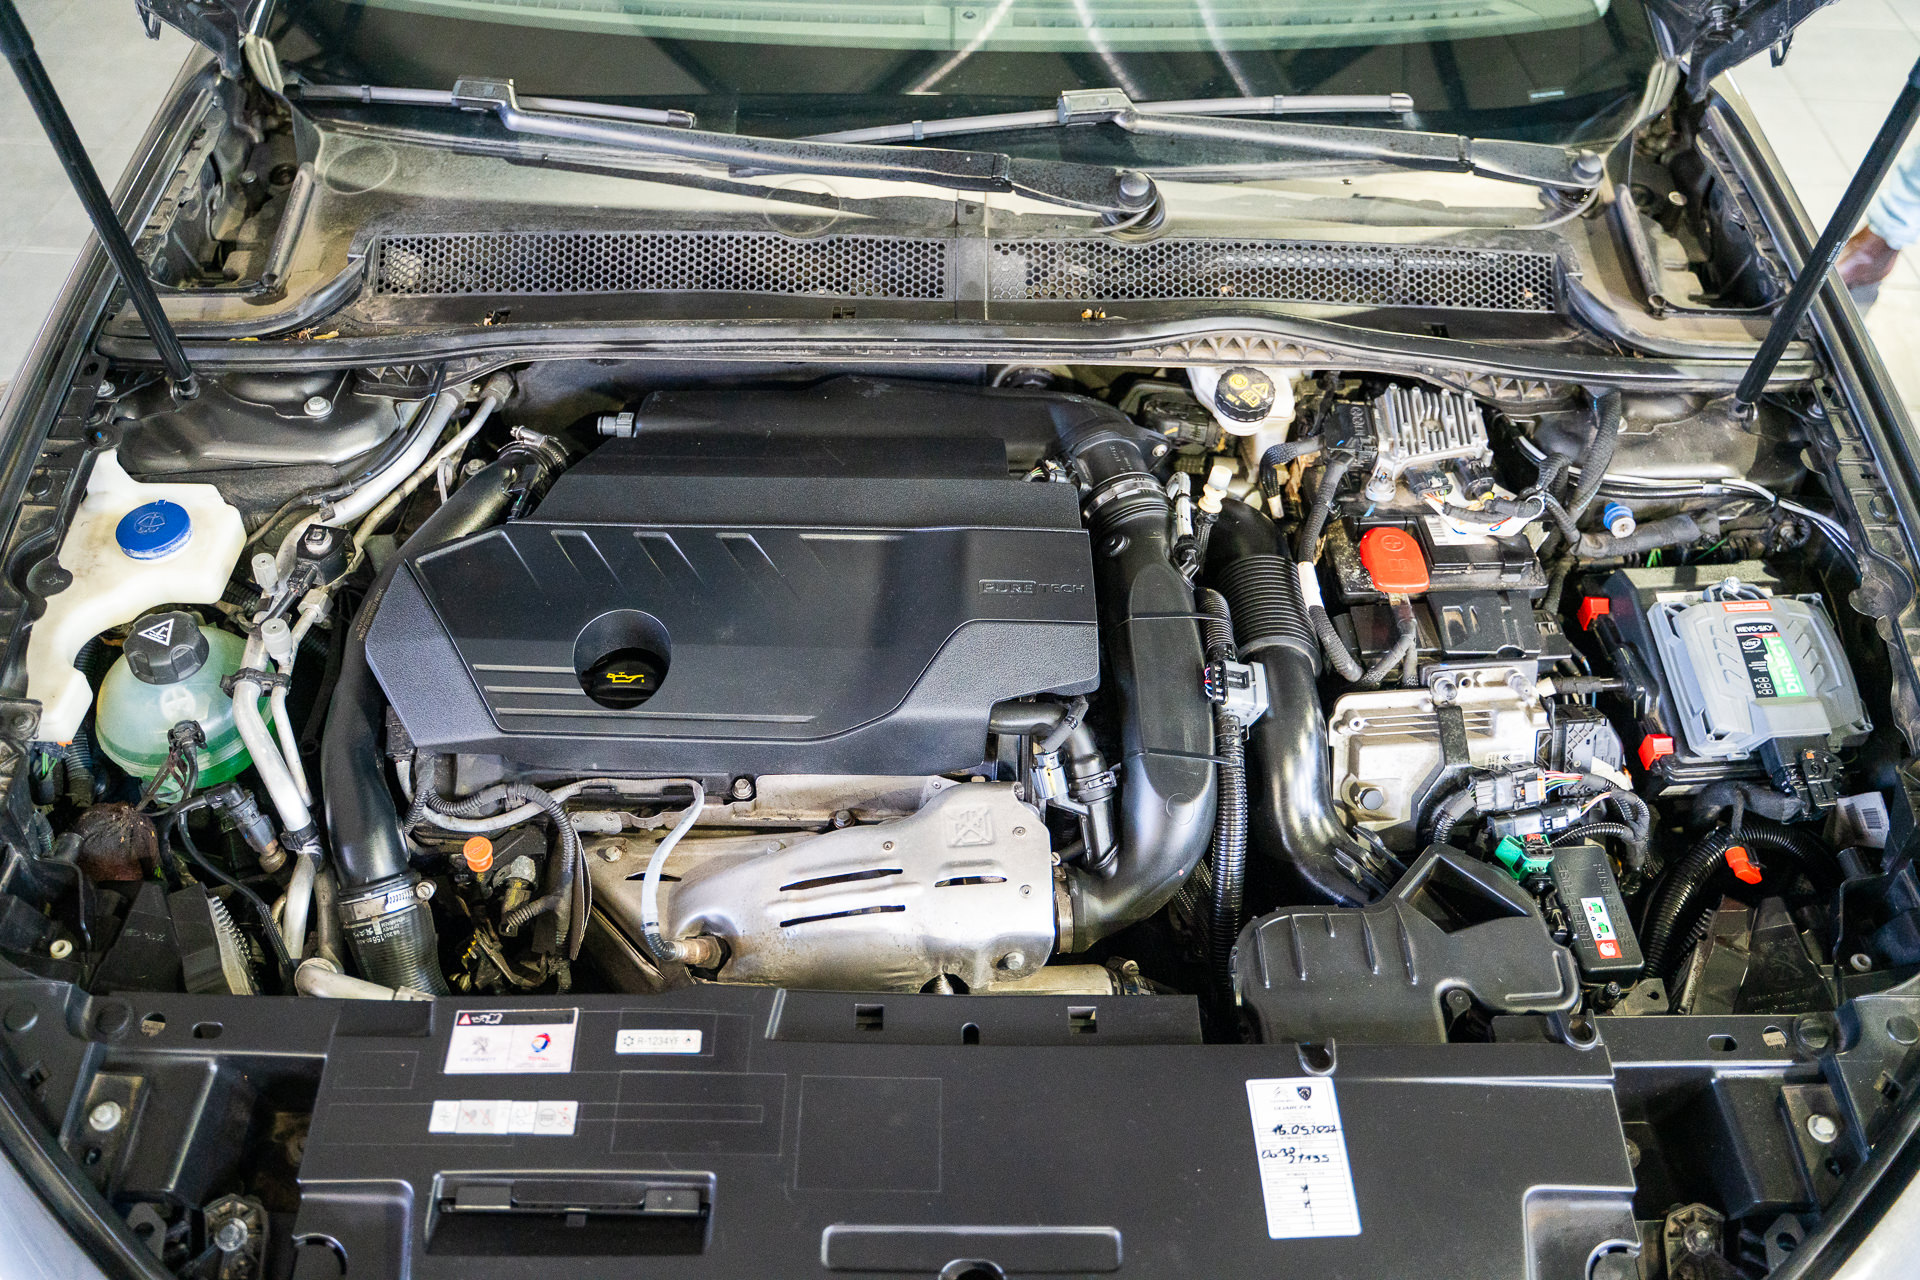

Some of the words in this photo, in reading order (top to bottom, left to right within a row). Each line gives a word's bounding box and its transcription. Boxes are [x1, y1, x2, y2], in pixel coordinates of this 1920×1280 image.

[982, 582, 1033, 594] PURE
[1038, 583, 1086, 595] TECH
[1736, 624, 1773, 633] NEVO-SKY
[1767, 637, 1802, 694] DIRECT
[1557, 864, 1577, 895] FUSE
